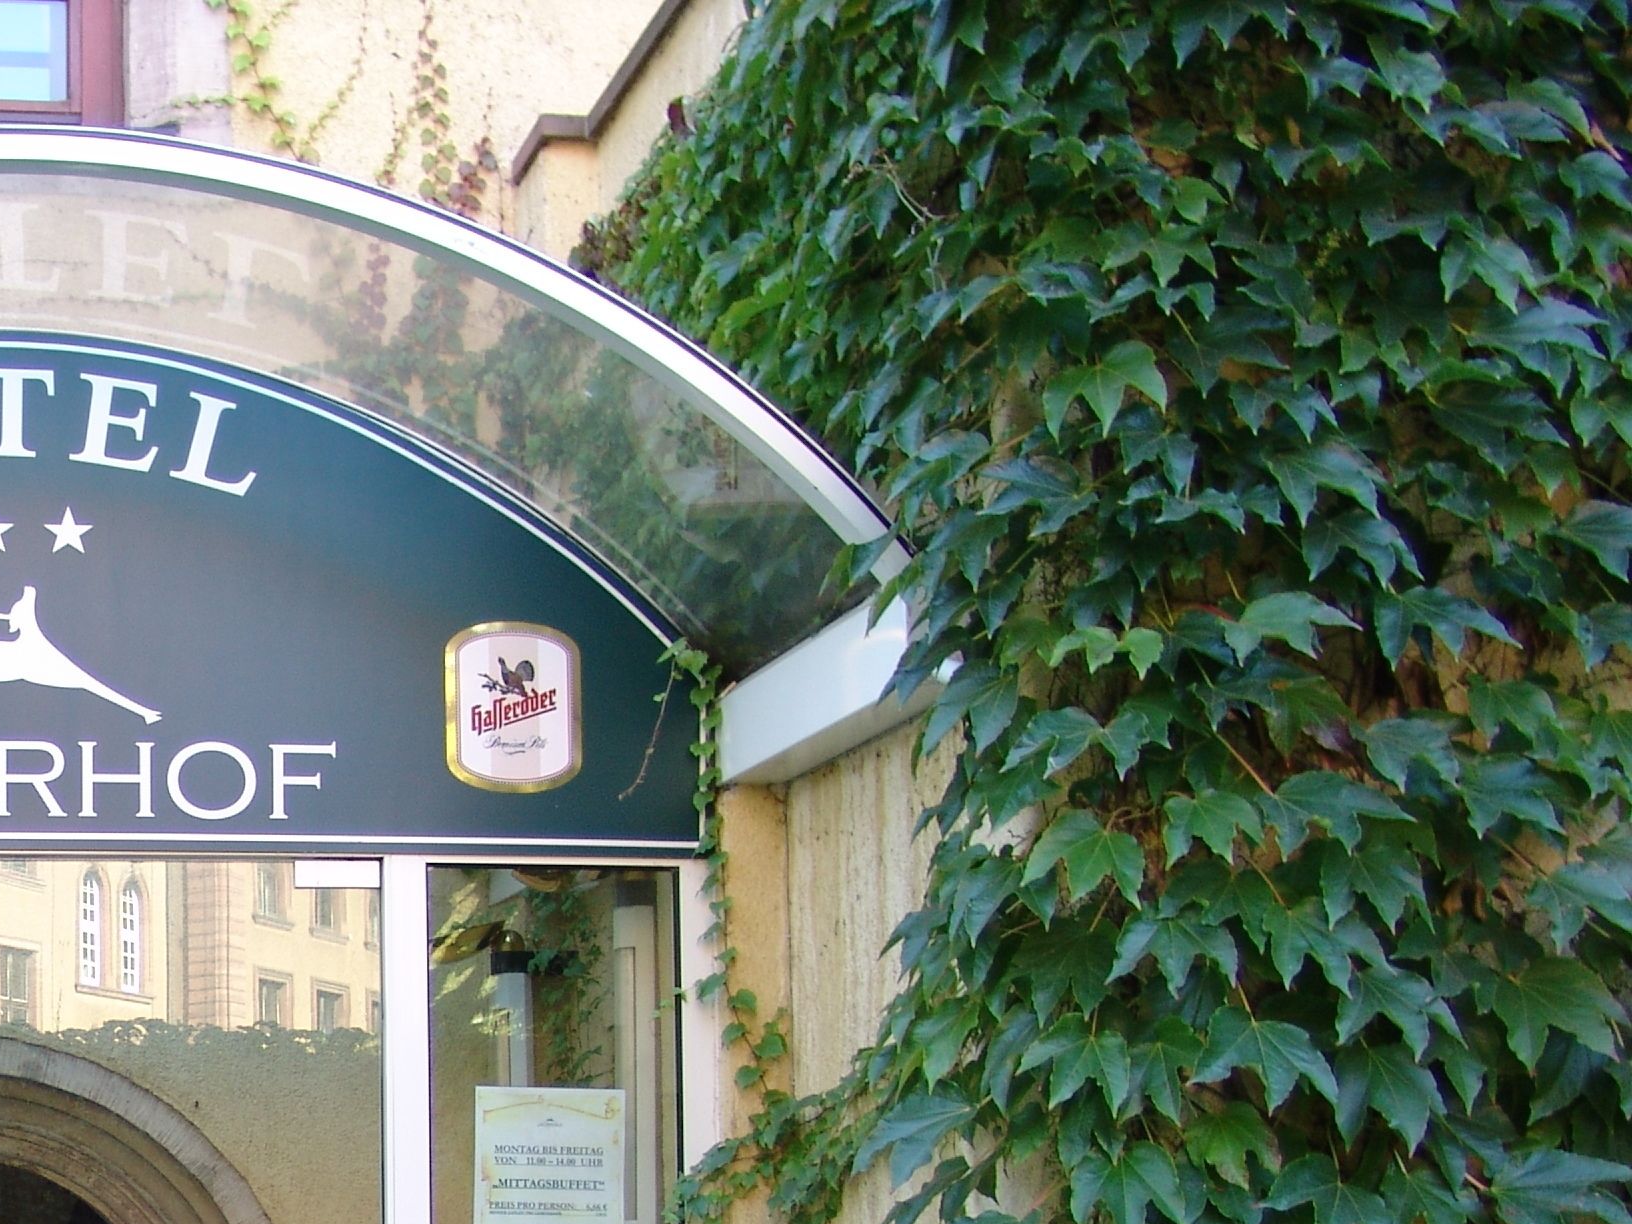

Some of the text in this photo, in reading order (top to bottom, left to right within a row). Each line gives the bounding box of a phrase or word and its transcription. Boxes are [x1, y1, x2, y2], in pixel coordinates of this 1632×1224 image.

[494, 1144, 604, 1156] MONTAG BIS FREITAG
[494, 1156, 517, 1165] VON
[581, 1158, 604, 1167] UHR
[489, 1201, 516, 1209] PREIS
[517, 1201, 536, 1209] PRO
